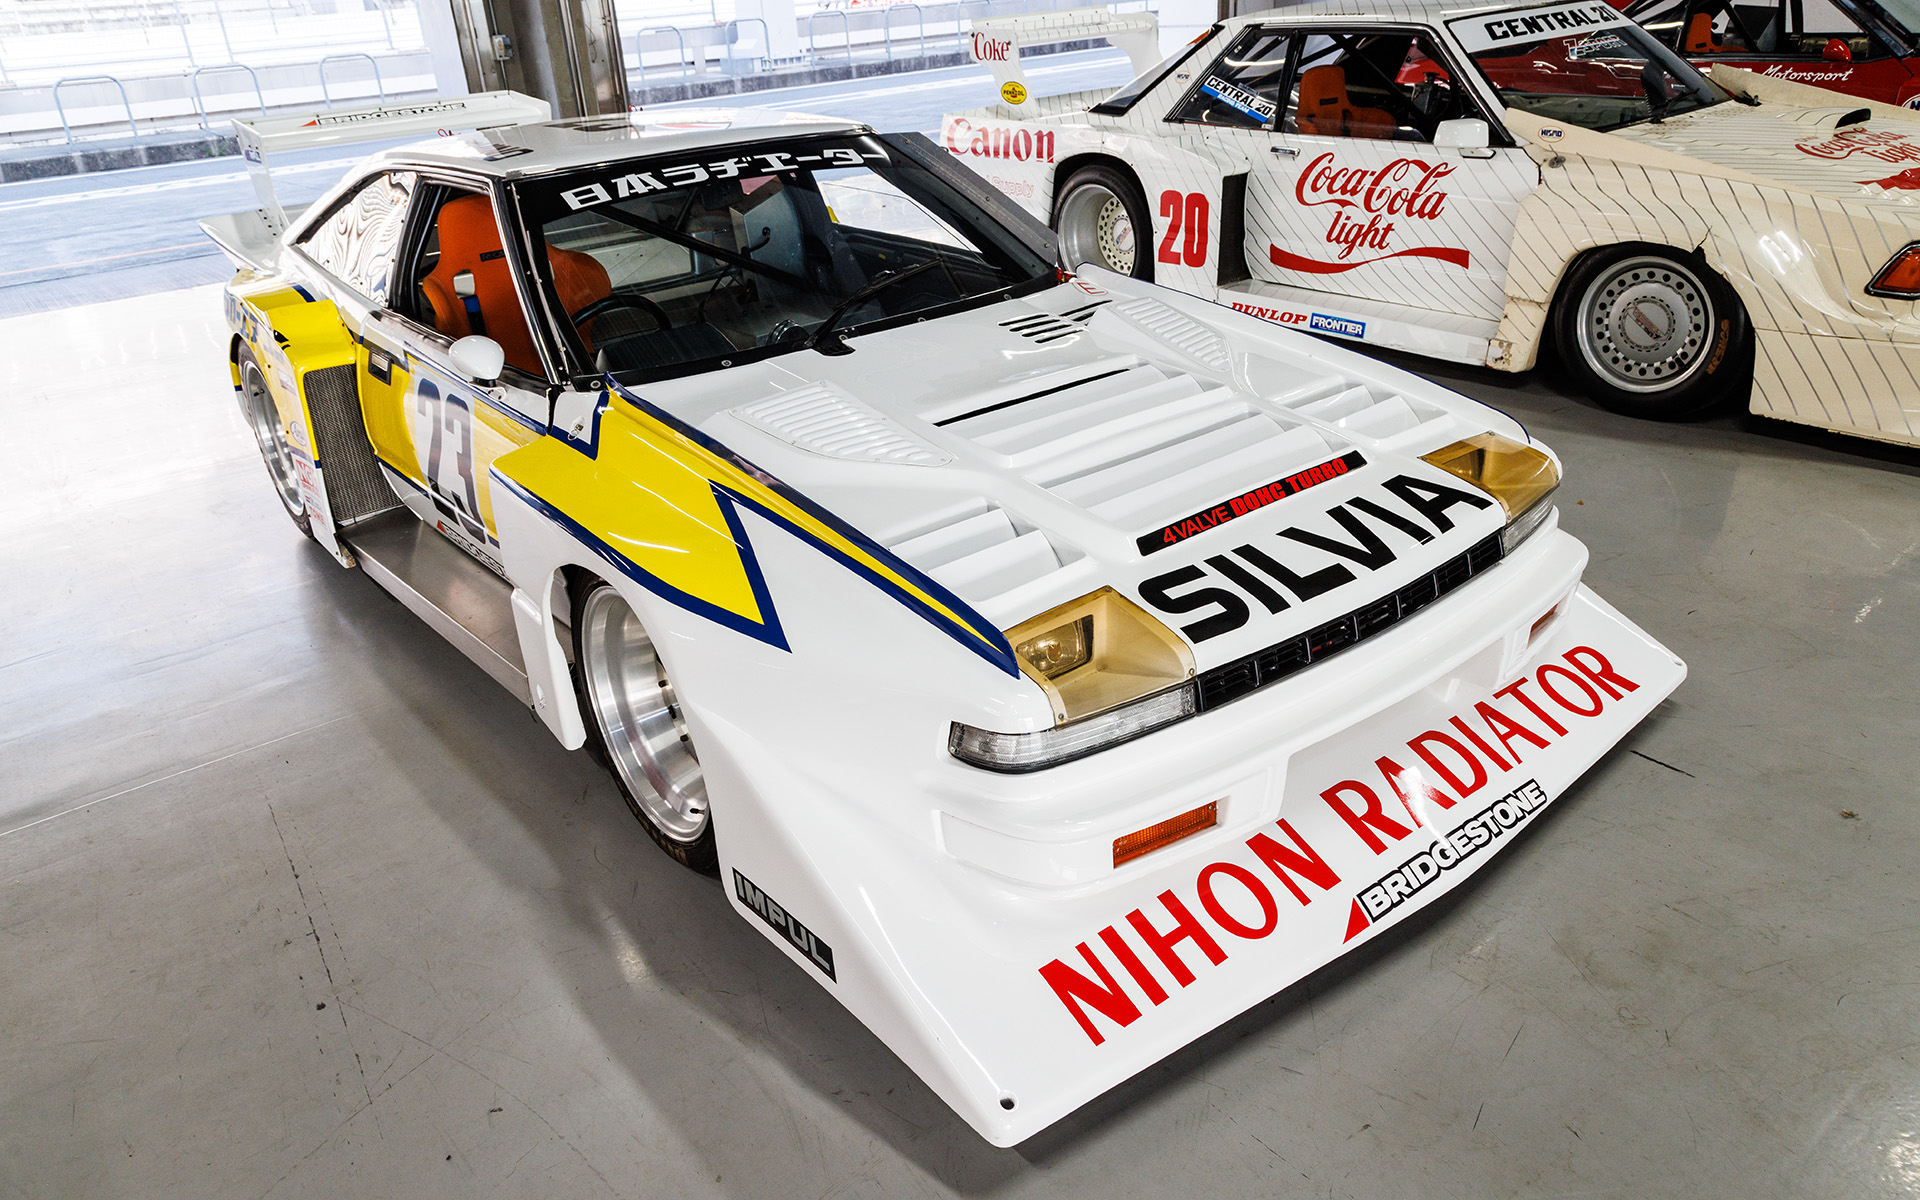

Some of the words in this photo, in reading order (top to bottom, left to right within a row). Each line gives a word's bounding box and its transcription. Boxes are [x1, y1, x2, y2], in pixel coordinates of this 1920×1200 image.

[974, 31, 1010, 61] Coke
[1206, 77, 1255, 109] CENTRAL
[1254, 103, 1273, 117] 20
[1762, 64, 1854, 82] Motorsport
[316, 102, 467, 126] BRIDGESTONE
[947, 118, 1055, 163] Canon
[992, 175, 1035, 198] Supply
[1295, 152, 1458, 220] Coca-Cola
[1158, 189, 1210, 268] 20
[1326, 211, 1395, 260] light
[1231, 302, 1308, 325] DUNLOP
[1312, 315, 1363, 335] FRONTIER
[417, 377, 487, 545] 23
[1229, 482, 1286, 517] DOHC
[1285, 457, 1349, 493] TURBO
[1138, 474, 1493, 644] SILVIA
[1038, 818, 1342, 1046] NIHON
[1319, 645, 1641, 856] RADIATOR
[1357, 778, 1548, 923] BRIDGESTONE
[735, 872, 831, 972] IMPUL
